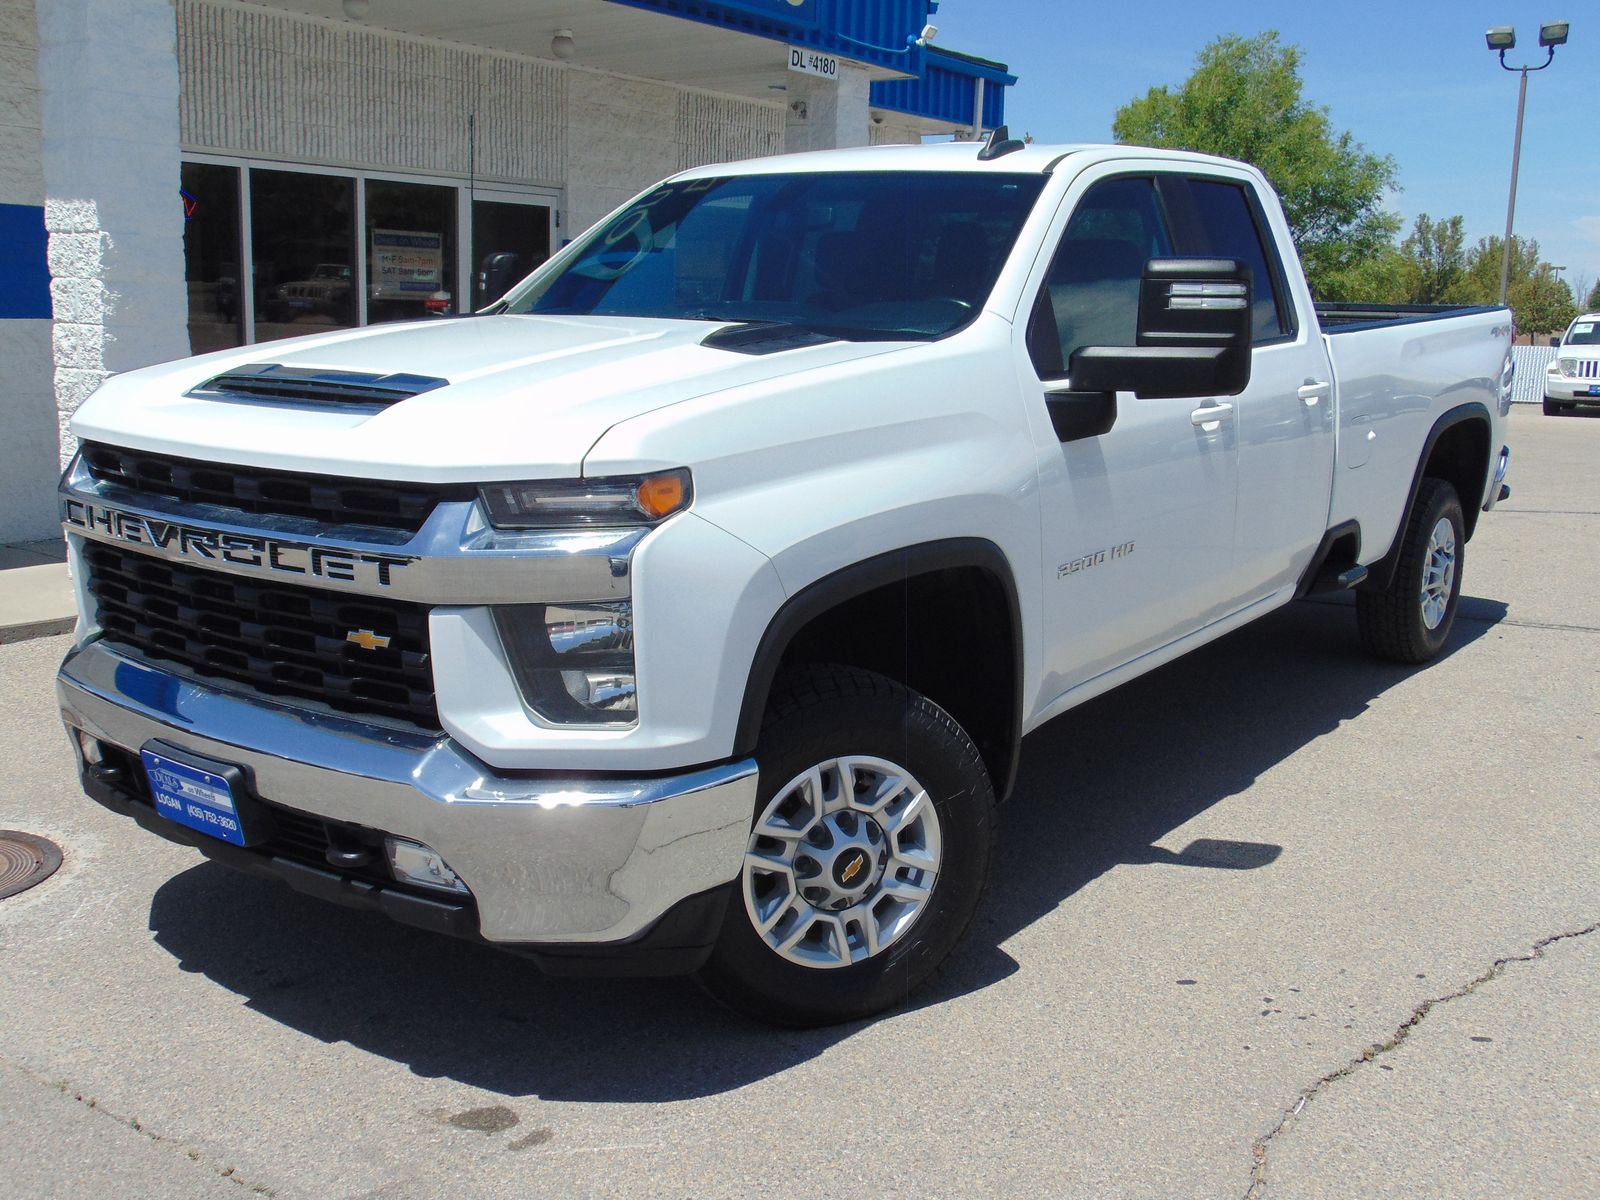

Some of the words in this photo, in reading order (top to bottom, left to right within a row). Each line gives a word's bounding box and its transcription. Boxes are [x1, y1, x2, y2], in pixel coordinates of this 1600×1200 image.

[791, 49, 806, 69] DL
[809, 55, 836, 75] #4180
[382, 266, 396, 275] SAT
[65, 498, 411, 586] CHEVROLET
[1057, 549, 1106, 580] 2500
[1111, 540, 1136, 560] HD
[156, 792, 182, 811] LOGAN
